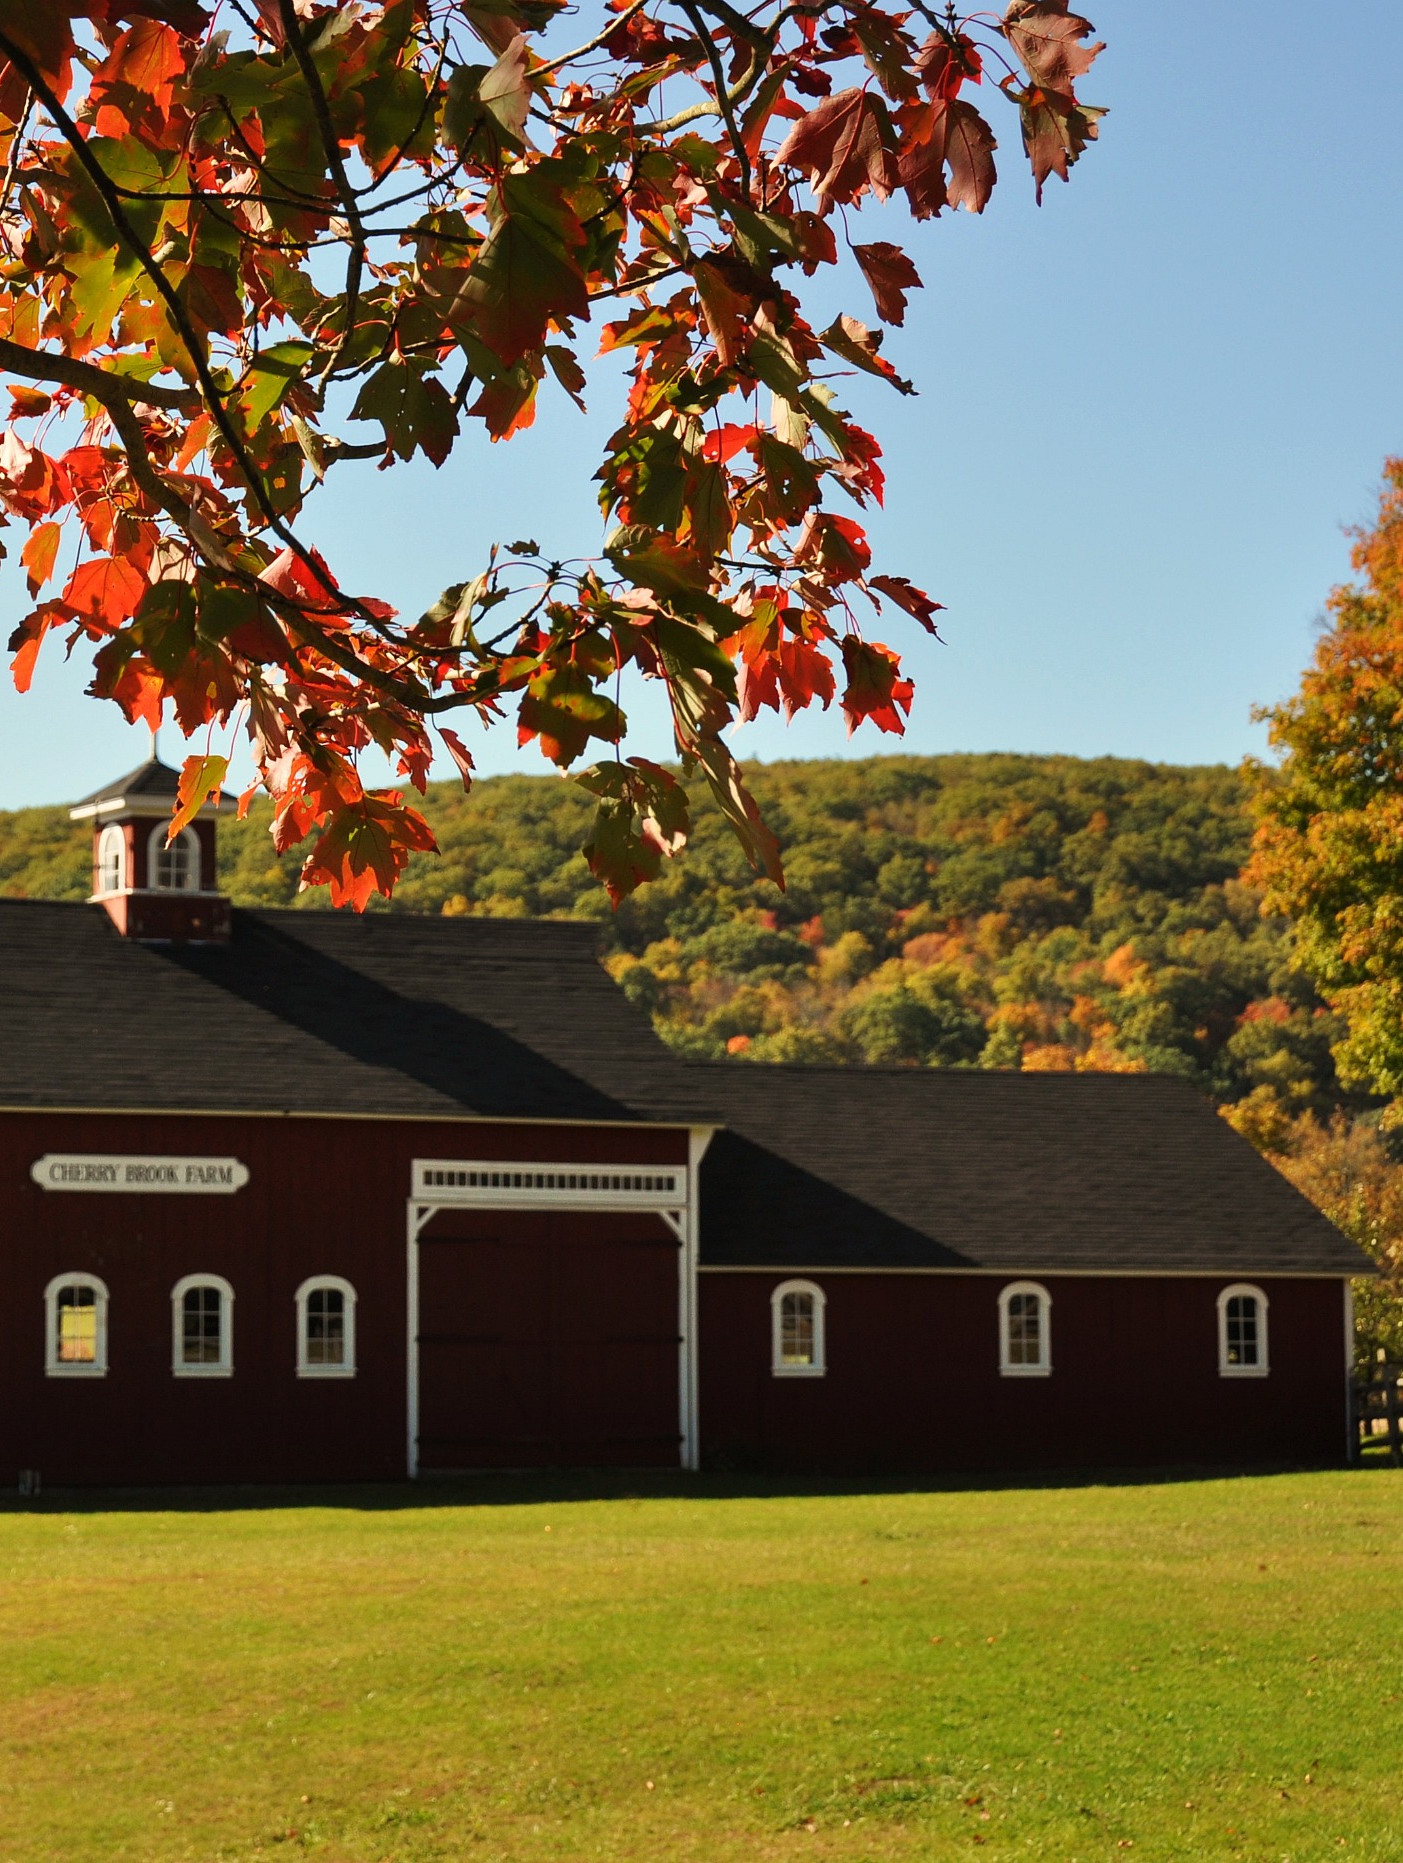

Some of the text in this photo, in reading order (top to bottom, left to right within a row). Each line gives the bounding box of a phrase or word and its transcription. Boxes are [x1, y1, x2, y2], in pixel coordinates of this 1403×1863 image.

[48, 1162, 233, 1185] CHERRY BROOK FARM
